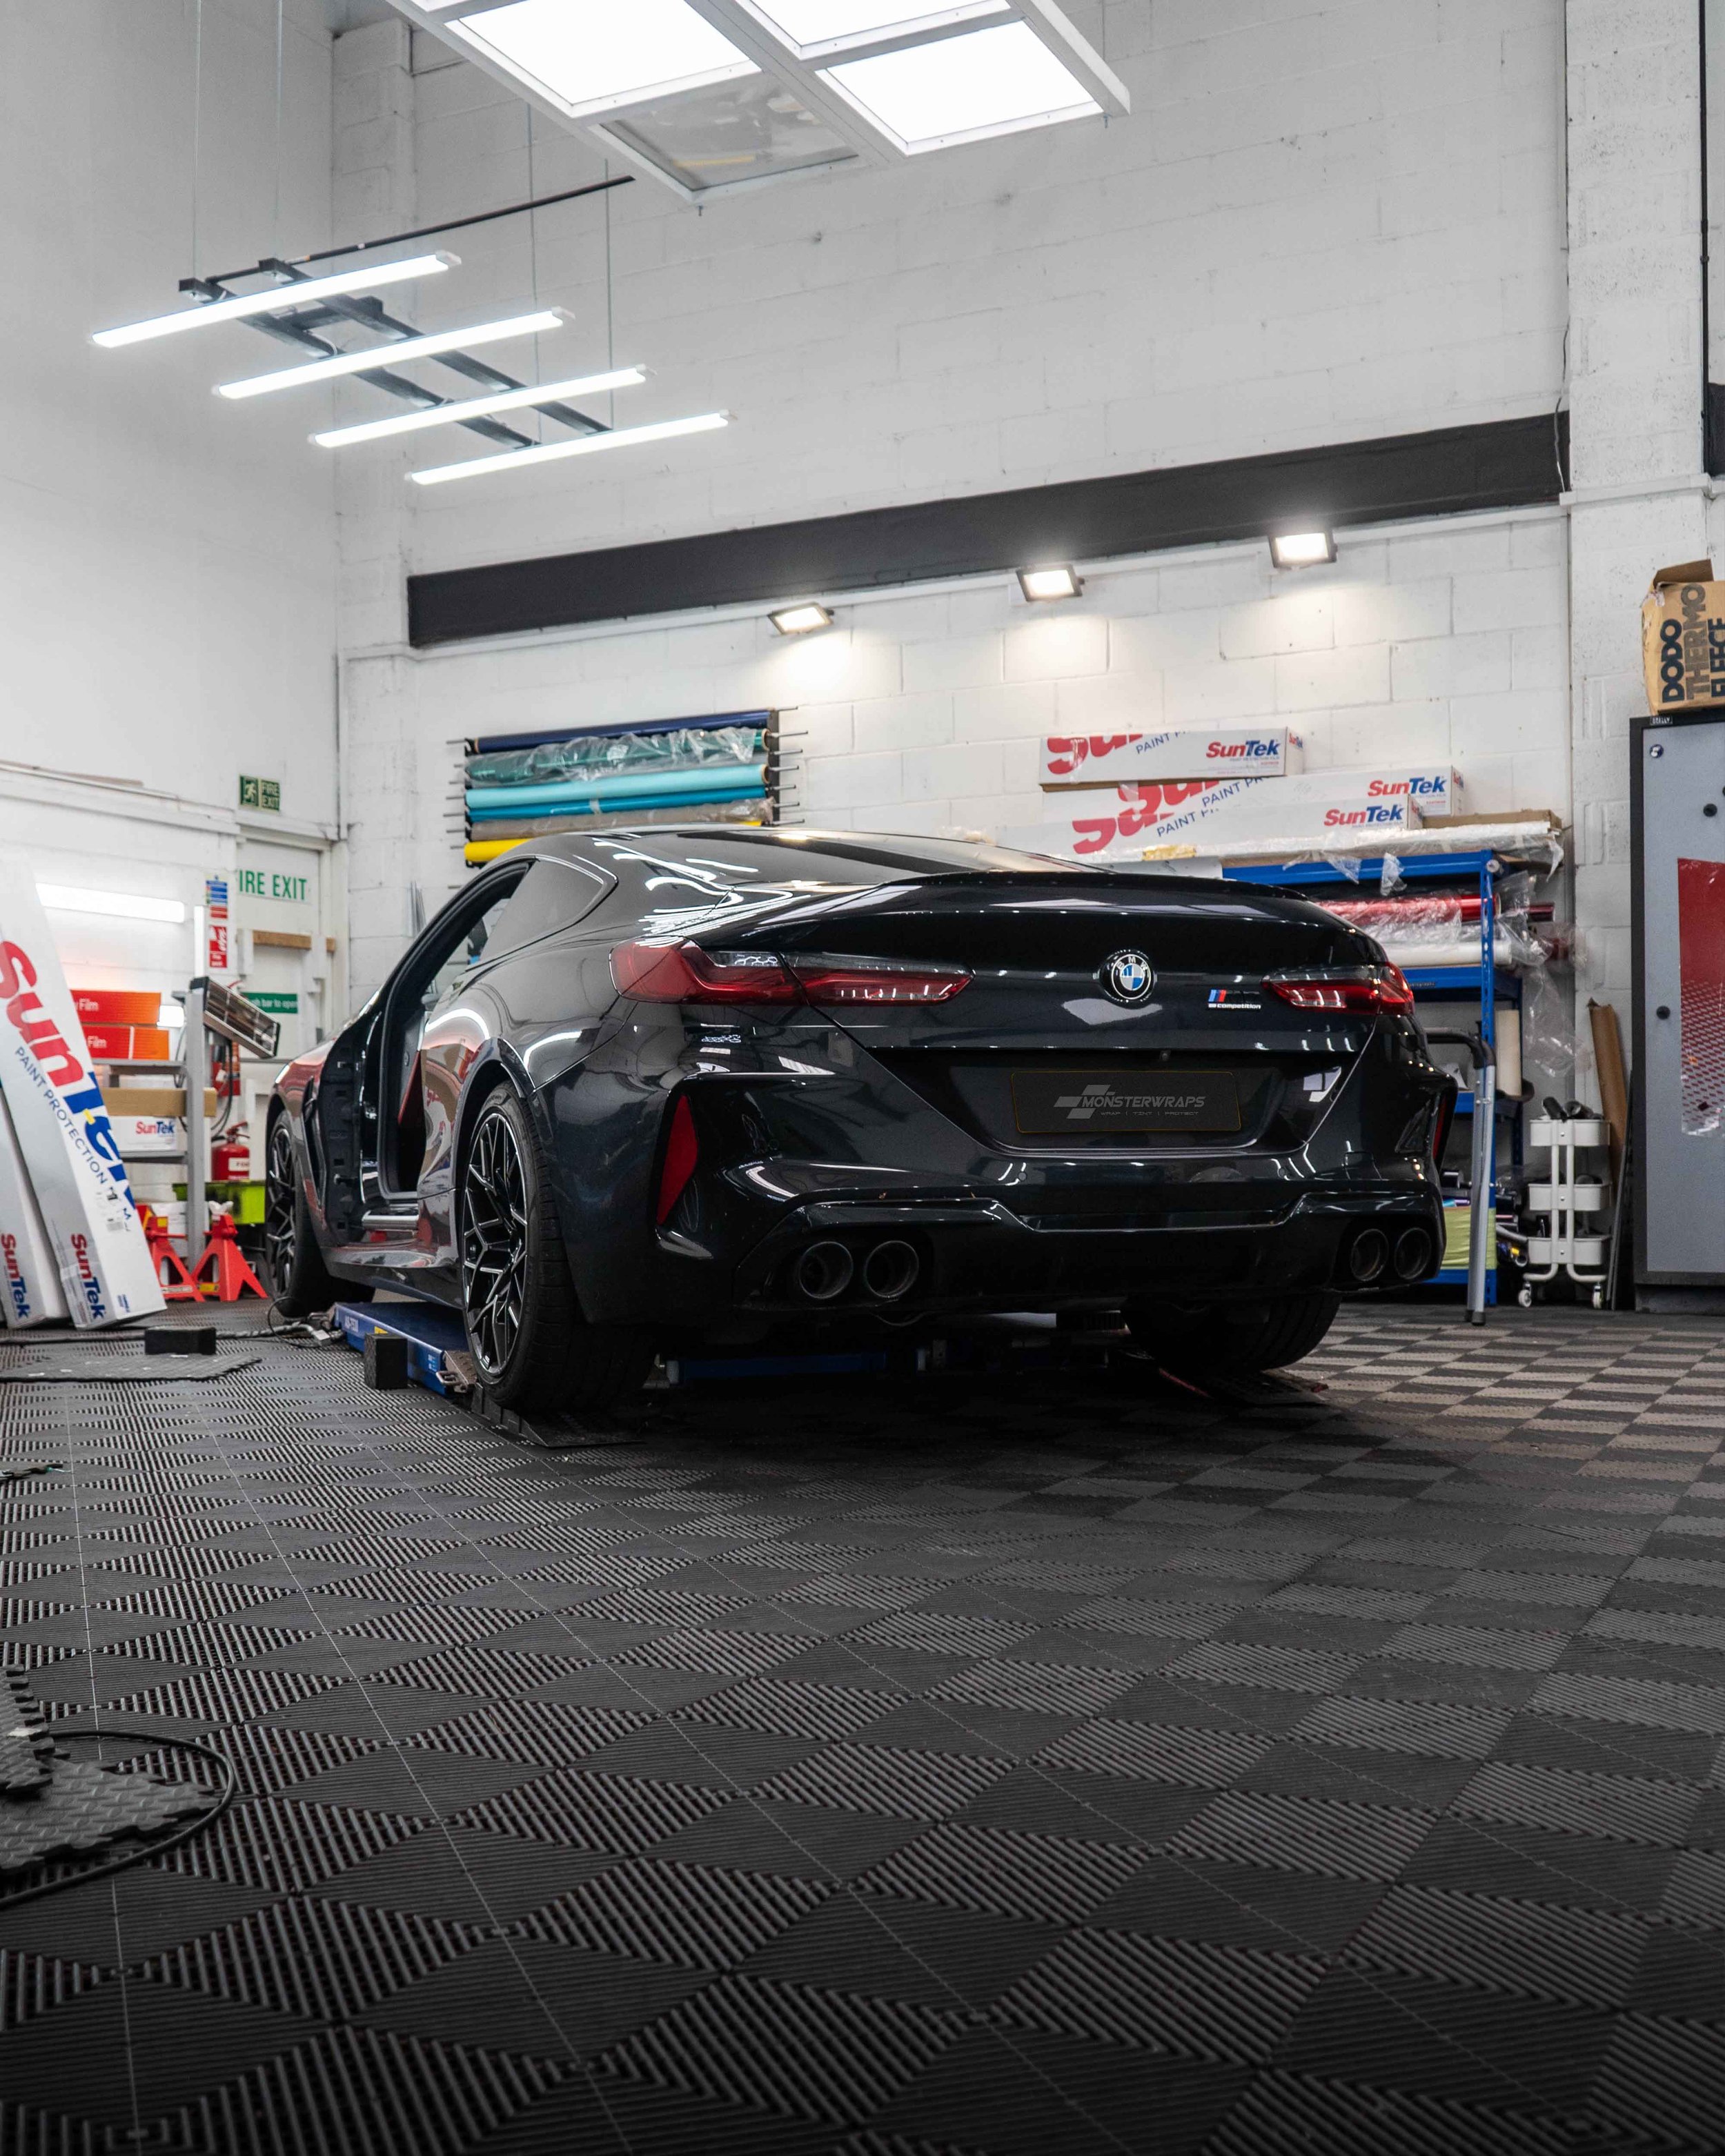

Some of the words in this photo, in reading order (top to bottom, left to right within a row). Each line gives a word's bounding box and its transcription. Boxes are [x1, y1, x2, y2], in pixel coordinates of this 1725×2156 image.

[1681, 582, 1711, 700] THERMO
[1660, 619, 1685, 702] DODO
[1136, 733, 1170, 754] PAINT
[1206, 739, 1281, 758] SunTek
[1202, 782, 1241, 807] PAINT
[1368, 775, 1446, 797] SunTek
[1156, 811, 1196, 837] PAINT
[1324, 804, 1403, 826] SunTek
[236, 869, 265, 895] IRE
[273, 874, 307, 900] EXIT
[1116, 956, 1149, 971] BMW
[79, 998, 99, 1011] Film
[88, 1036, 107, 1049] Film
[1081, 1096, 1206, 1108] MONSTERWRAPS
[14, 1046, 46, 1091] PAINT
[43, 1089, 108, 1185] PROTECTION
[135, 1120, 175, 1135] SunTek
[1, 1234, 30, 1318] SunTek
[71, 1234, 106, 1319] SunTek
